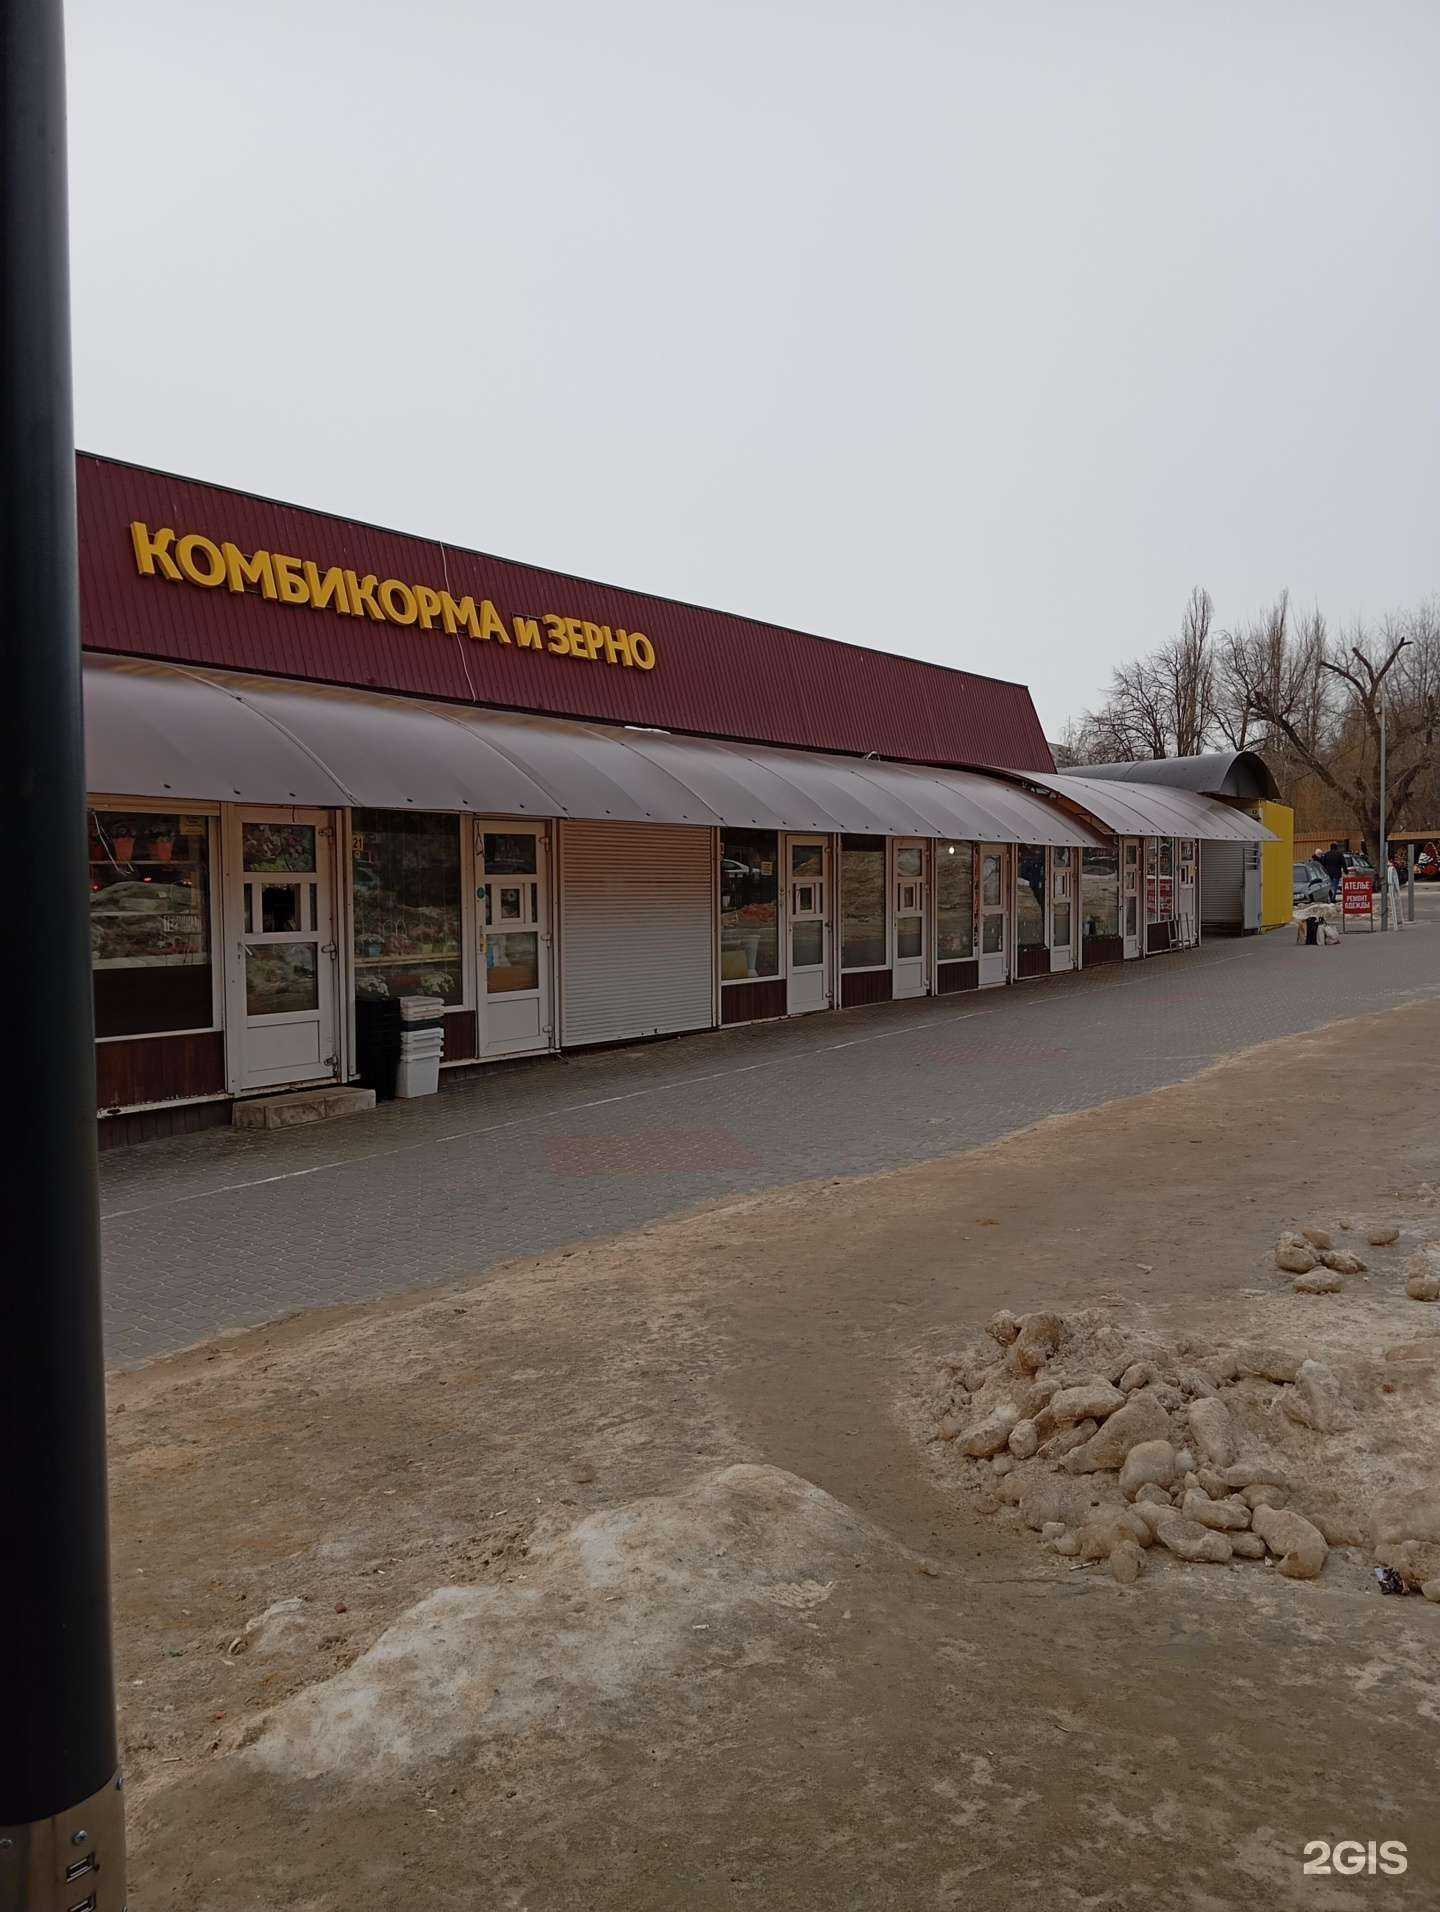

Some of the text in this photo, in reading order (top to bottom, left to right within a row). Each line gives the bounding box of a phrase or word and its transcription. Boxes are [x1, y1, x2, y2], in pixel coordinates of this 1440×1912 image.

[130, 521, 656, 670] КОМБИКОРМА и ЗЕРНО
[1344, 881, 1370, 890] АТЕЛЬЕ
